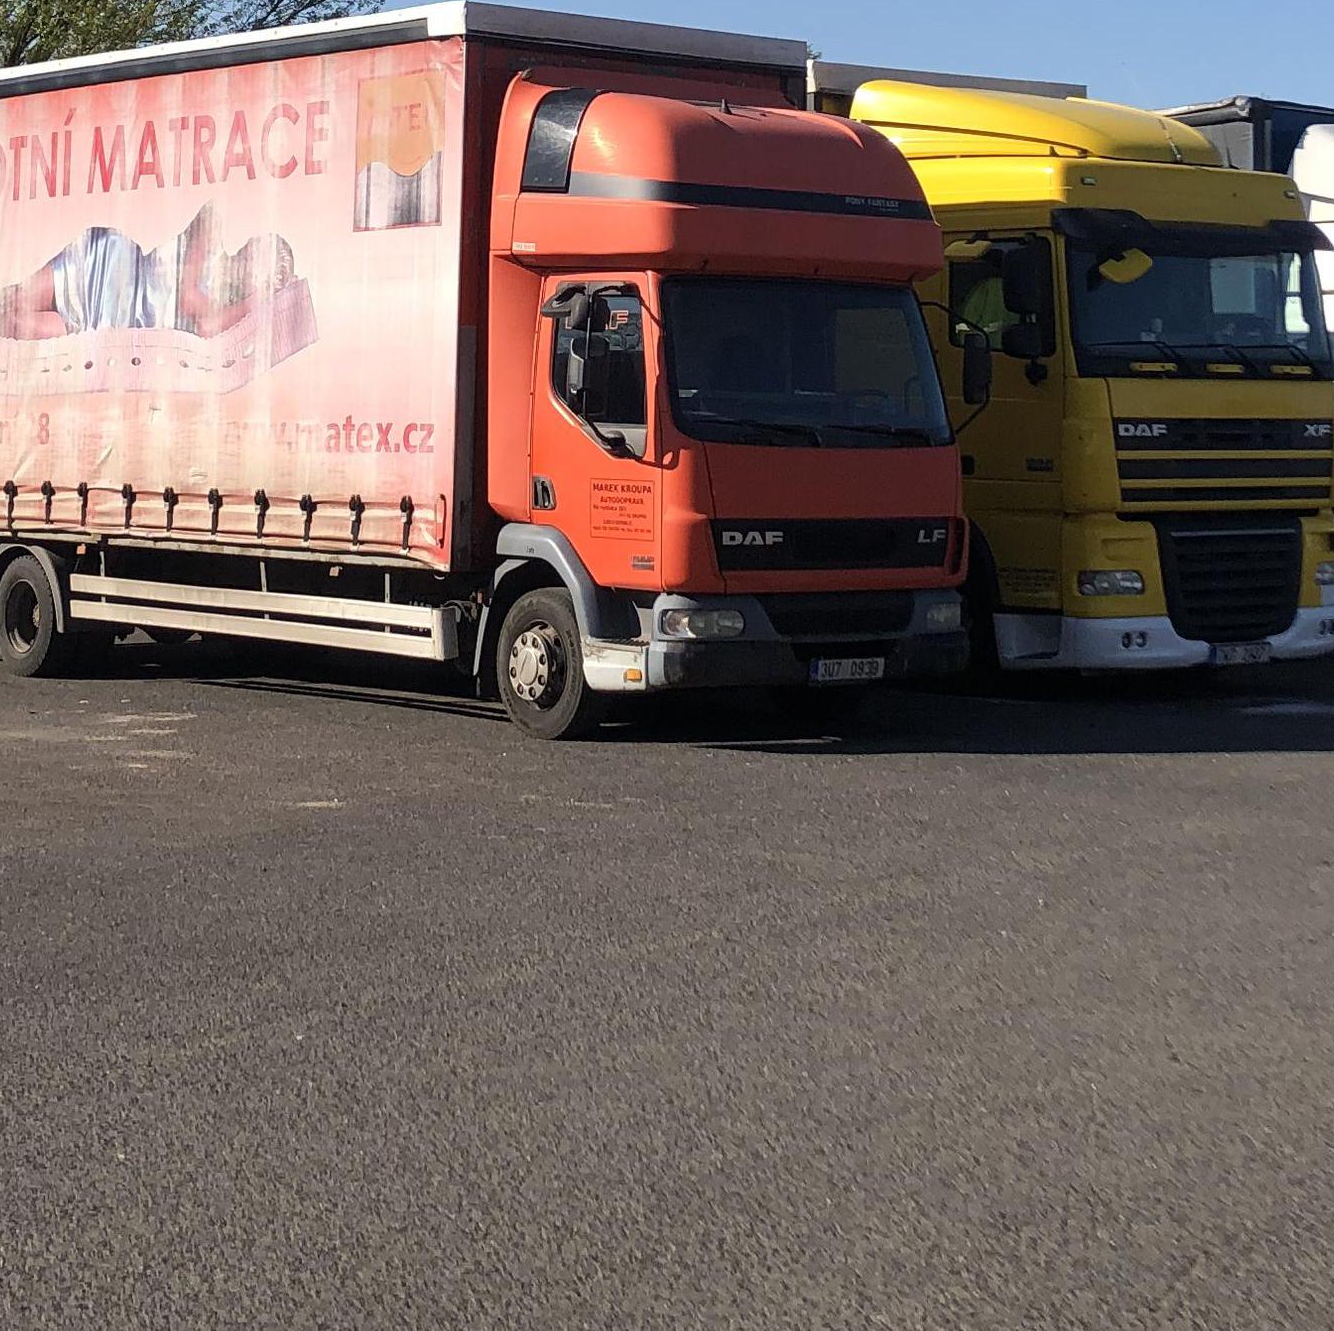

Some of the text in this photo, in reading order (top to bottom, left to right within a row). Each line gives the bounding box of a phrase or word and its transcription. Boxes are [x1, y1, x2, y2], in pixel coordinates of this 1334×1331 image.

[87, 100, 330, 194] MATRACE
[223, 414, 435, 454] .matex.cz
[1117, 423, 1331, 437] DAF XF
[593, 483, 652, 493] MAREK KROUPA
[722, 529, 946, 545] DAF LF
